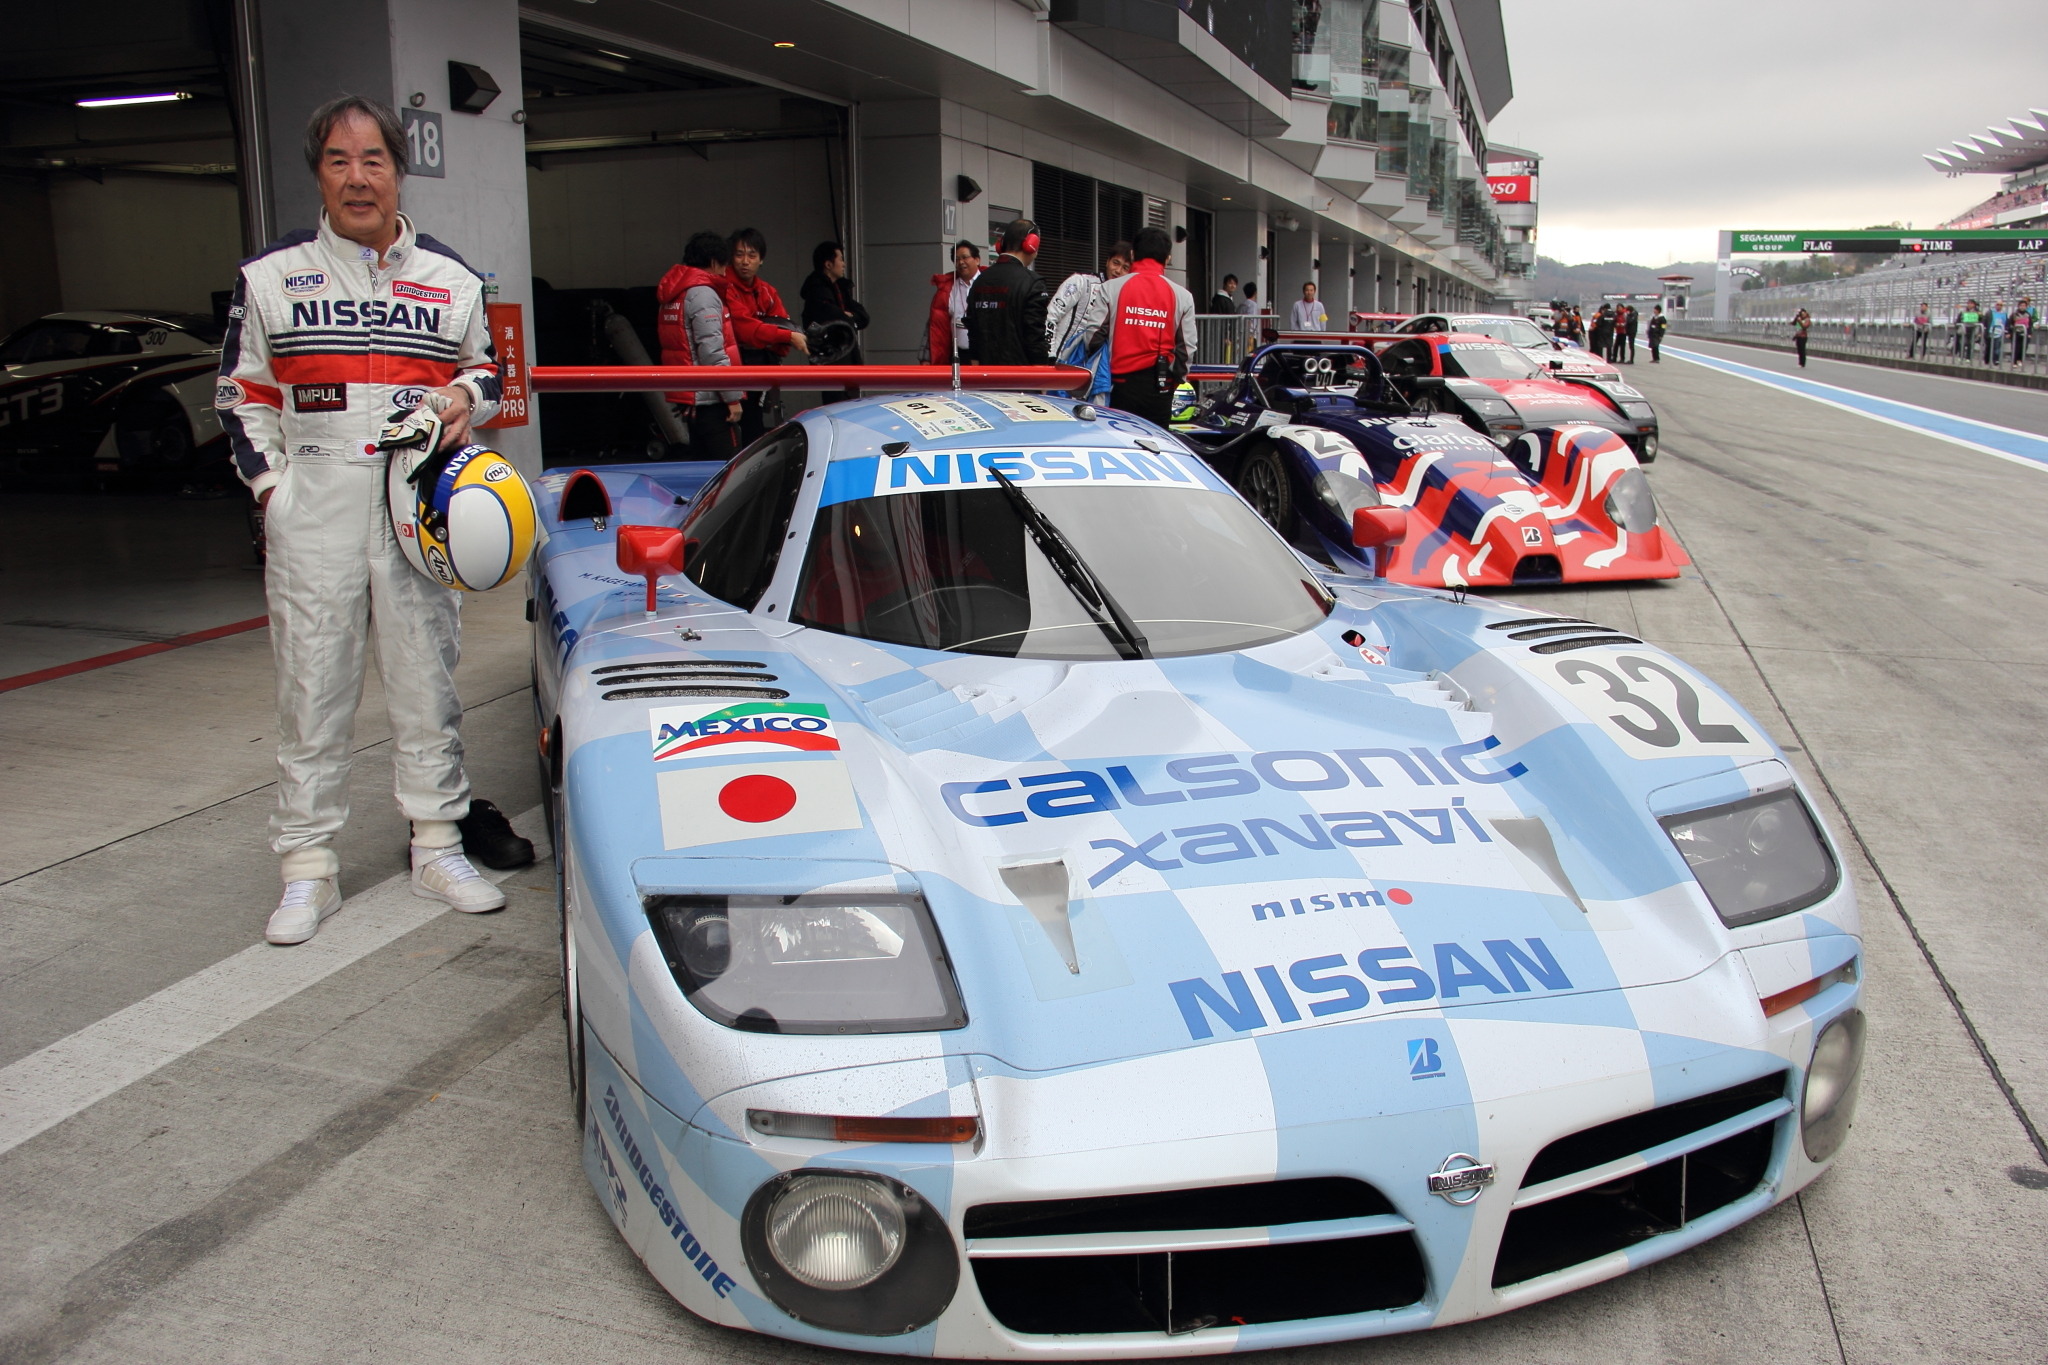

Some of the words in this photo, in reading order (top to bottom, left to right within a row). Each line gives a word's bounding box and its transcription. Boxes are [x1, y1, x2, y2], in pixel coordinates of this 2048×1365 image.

[407, 119, 441, 168] 18
[945, 204, 956, 230] 17
[1802, 240, 1833, 251] FLAG
[1921, 240, 1953, 251] TIME
[2017, 239, 2044, 250] LAP
[285, 273, 324, 289] NISMO
[396, 284, 448, 300] BRIDGESTONE
[292, 299, 441, 334] NISSAN
[1125, 305, 1168, 319] NISSAN
[1124, 317, 1166, 329] nismo
[145, 331, 168, 346] 300
[504, 326, 517, 378] 消火器
[297, 388, 342, 403] IMPUL
[506, 386, 521, 395] 778
[502, 398, 526, 418] PR9
[890, 450, 1193, 489] NISSAN
[1554, 655, 1750, 749] 32
[657, 717, 828, 741] MEXICO
[1168, 936, 1574, 1041] NISSAN
[1434, 1169, 1491, 1190] NISSAN
[603, 1084, 737, 1299] BRIDGESTONE
